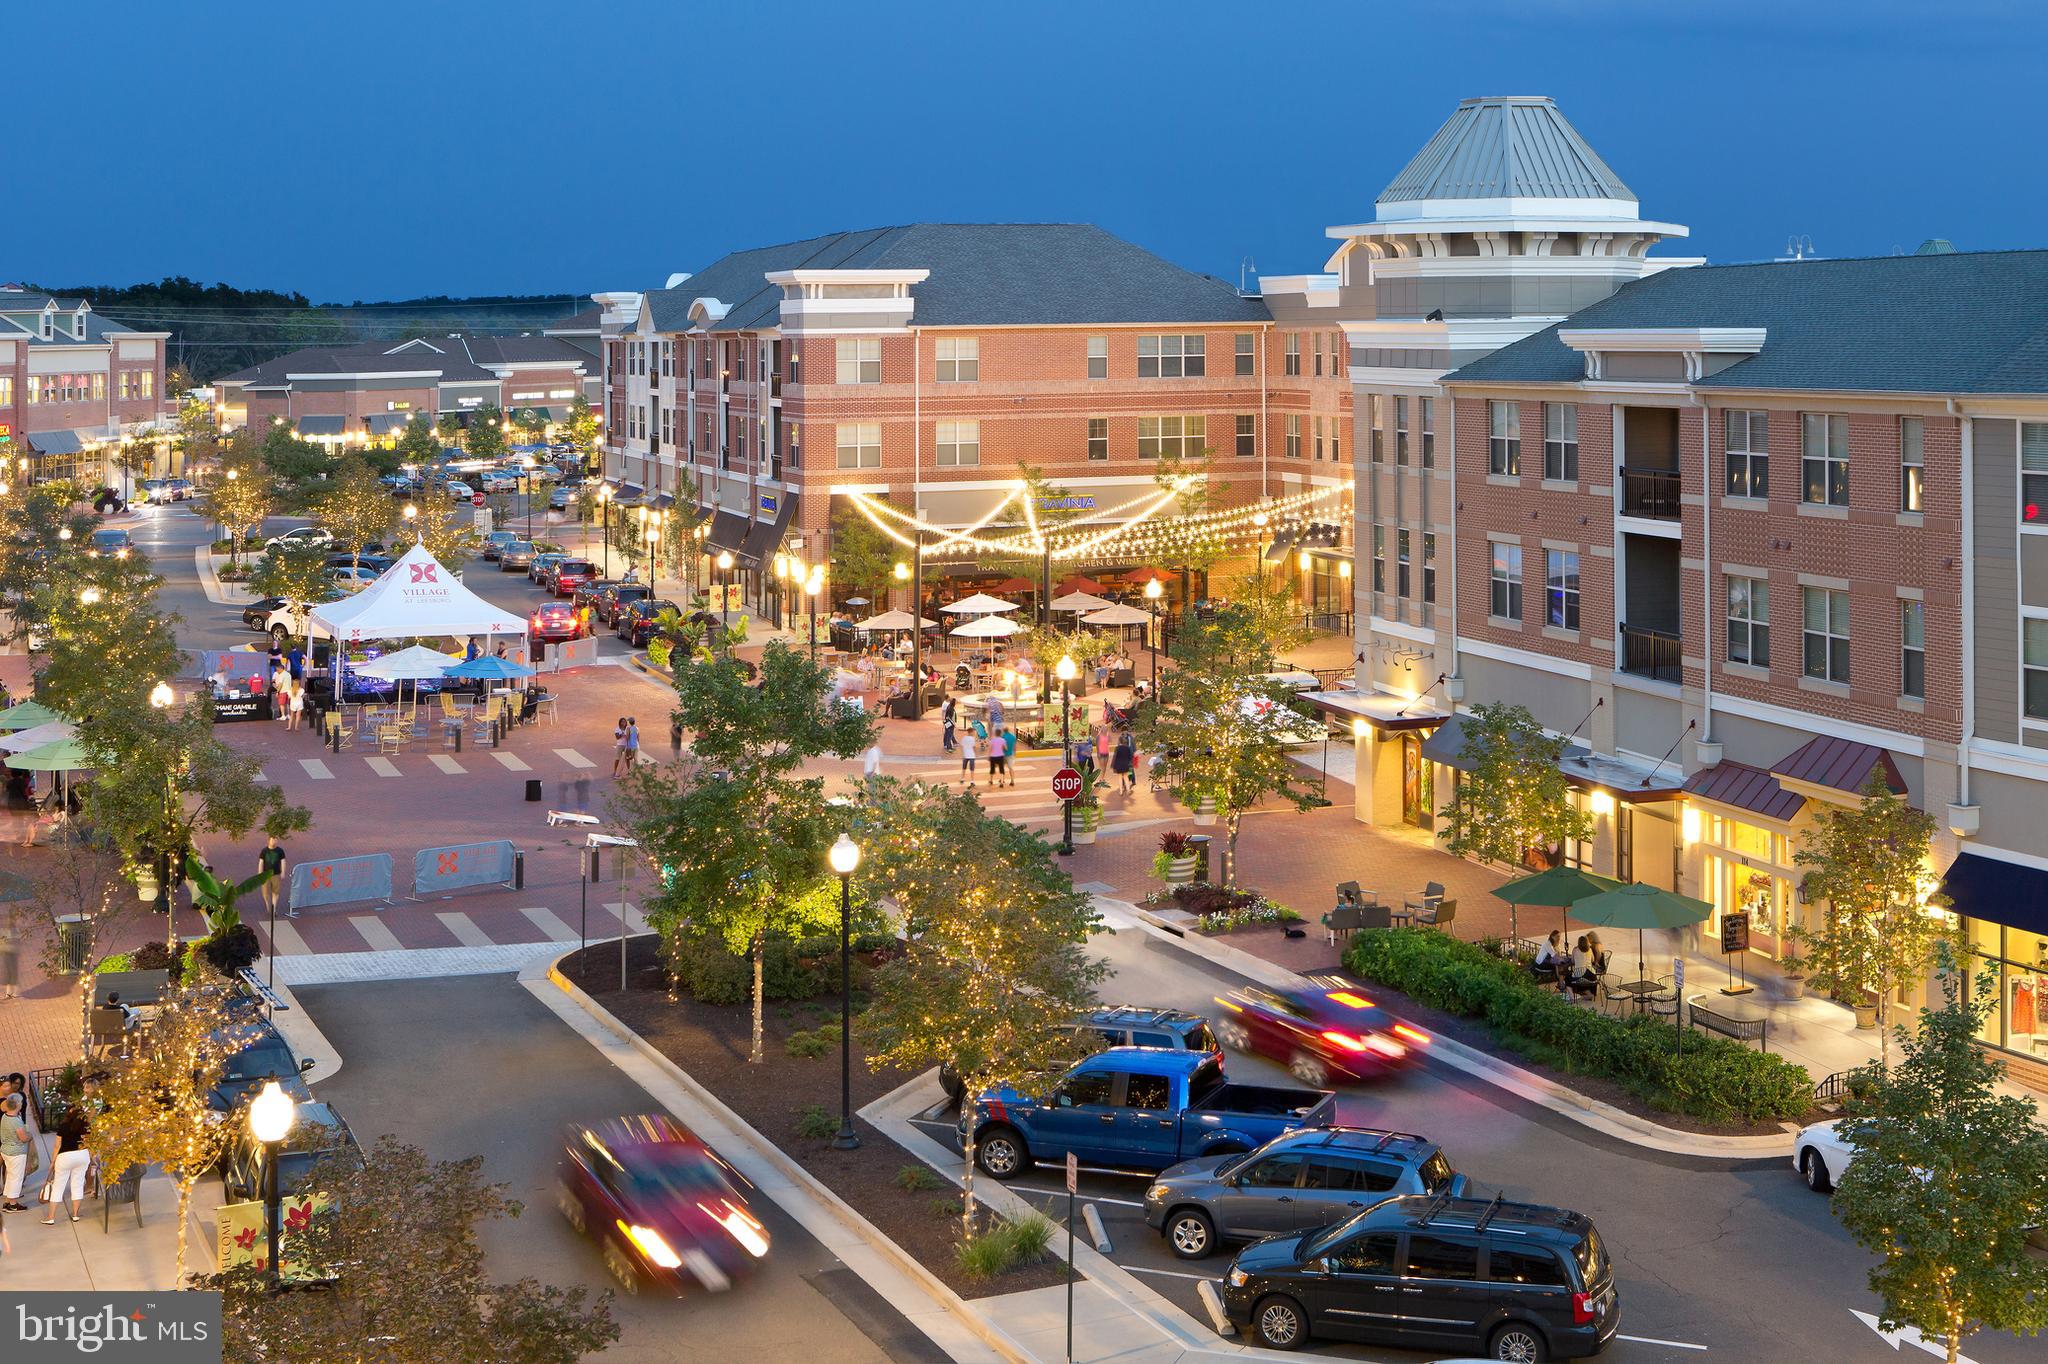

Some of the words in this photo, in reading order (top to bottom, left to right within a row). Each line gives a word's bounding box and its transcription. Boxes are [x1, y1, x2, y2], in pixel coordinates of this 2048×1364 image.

[1106, 558, 1113, 567] &
[1115, 557, 1142, 566] WINE
[402, 588, 449, 596] VILLAGE
[1054, 777, 1081, 790] STOP
[221, 1217, 232, 1271] ELCOME
